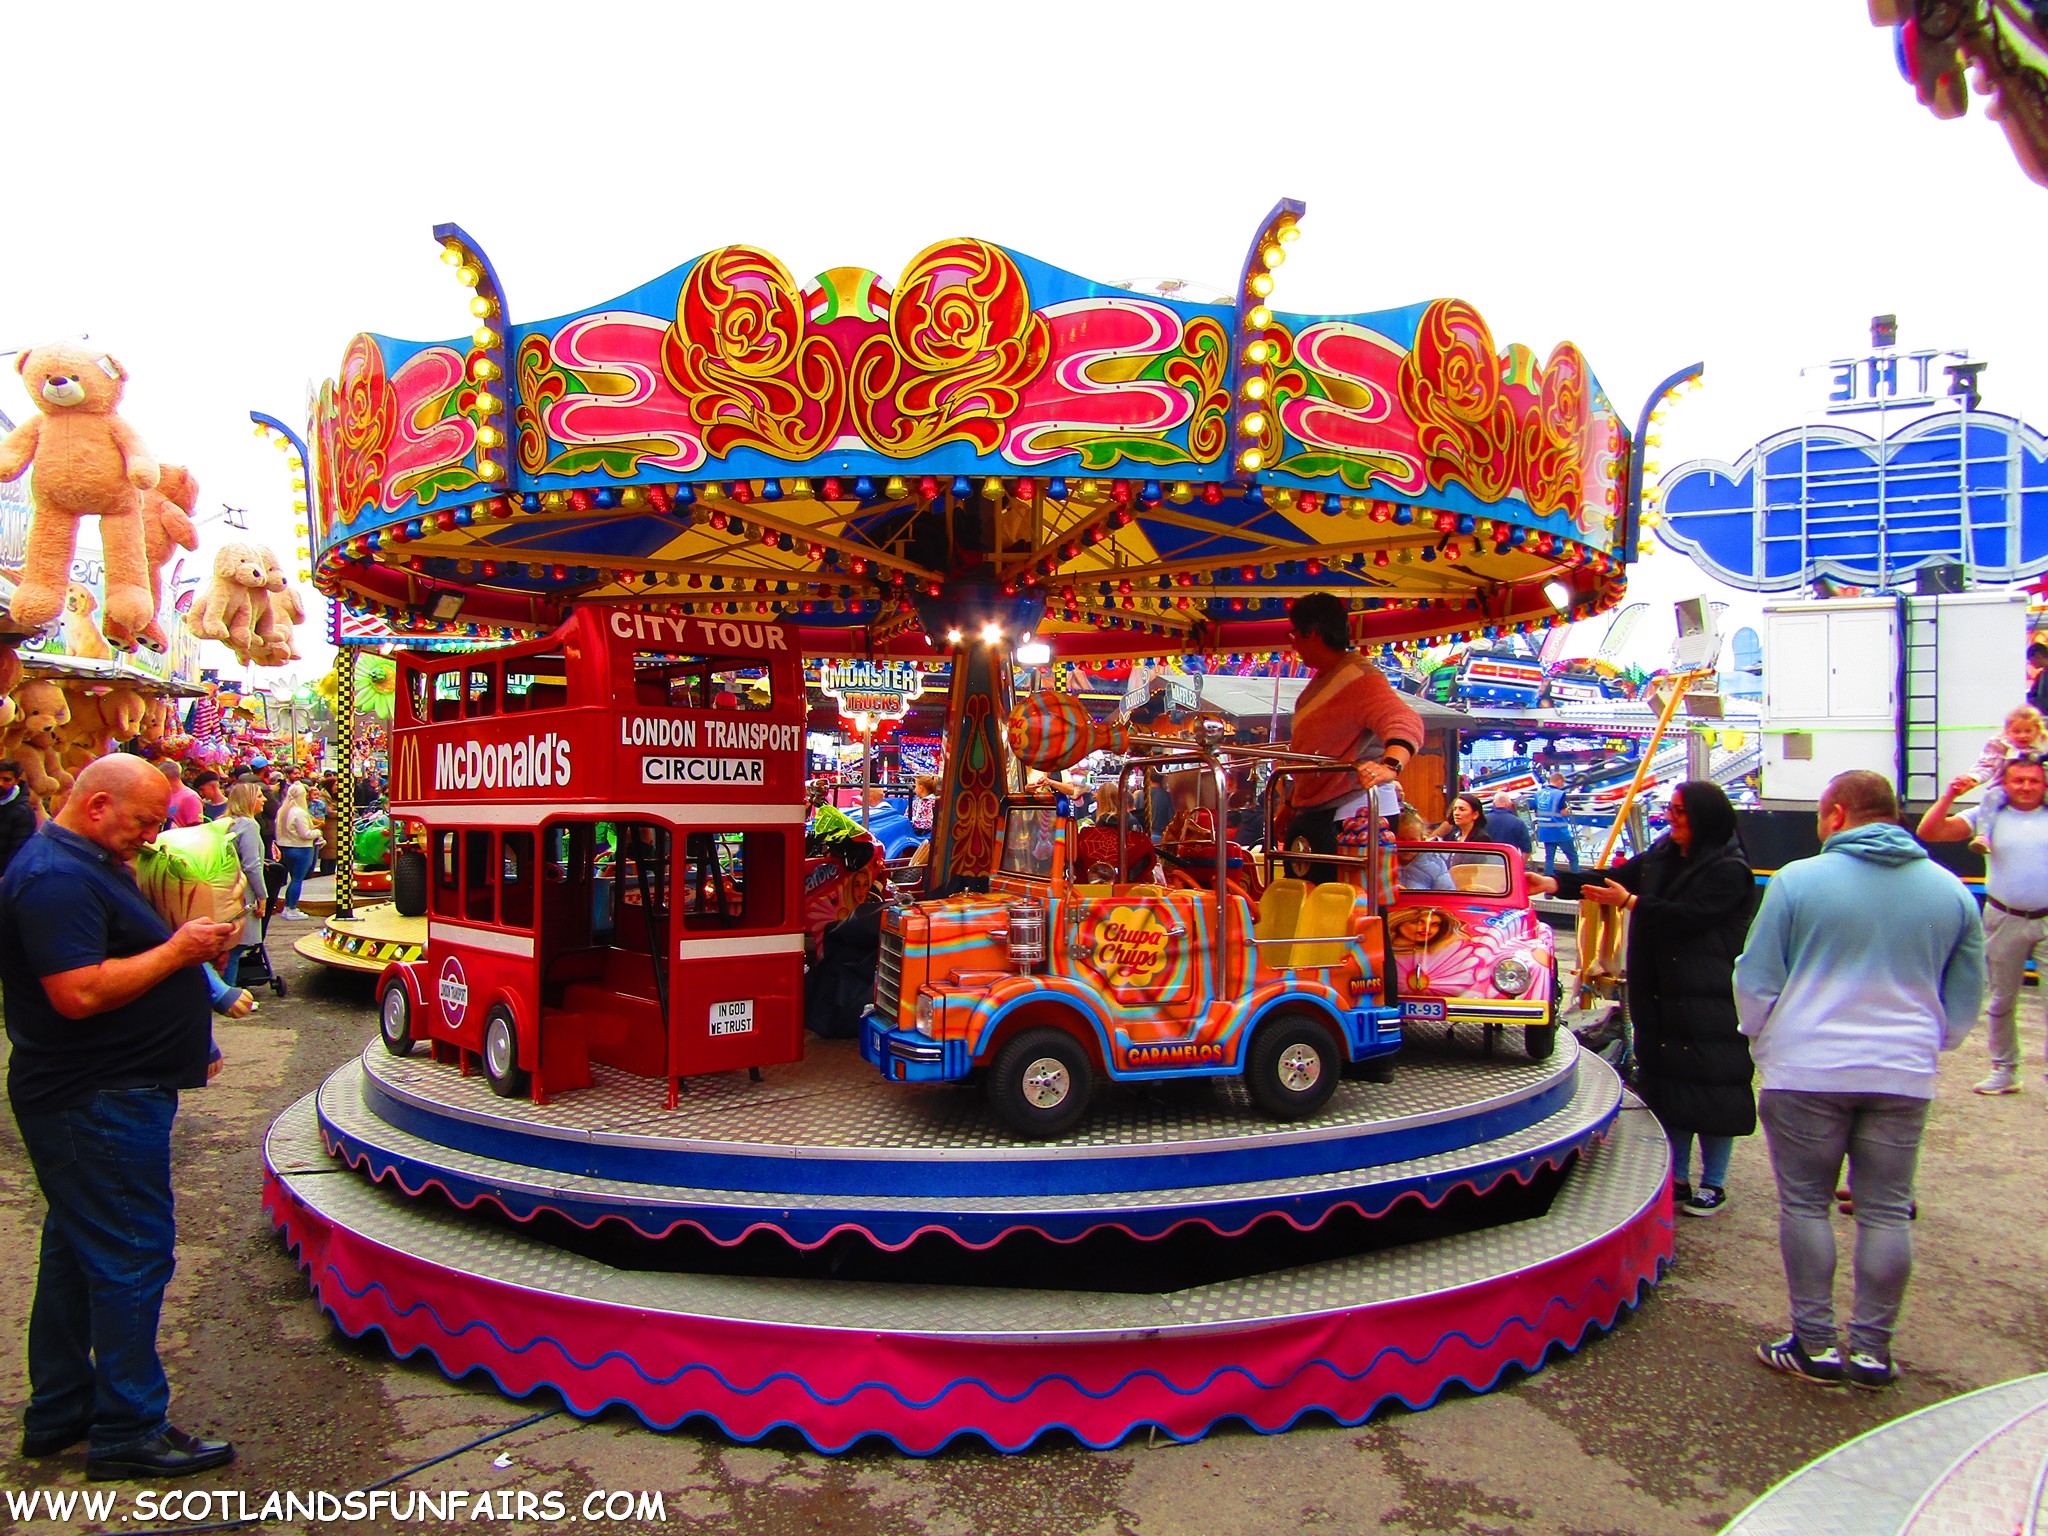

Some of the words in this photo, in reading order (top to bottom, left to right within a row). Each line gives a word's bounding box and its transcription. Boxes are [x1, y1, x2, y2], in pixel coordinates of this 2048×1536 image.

[610, 611, 687, 643] CITY
[697, 620, 788, 650] TOUR
[828, 662, 915, 692] MONSTER
[844, 692, 901, 711] TRUCKS
[1125, 687, 1147, 709] DONUTS
[1171, 682, 1197, 709] WAFFLES
[621, 716, 696, 747] LONDON
[704, 720, 800, 751] TRANSPORT
[435, 732, 571, 791] McDonald's
[645, 758, 762, 781] CIRCULAR
[805, 862, 839, 893] arbie
[1103, 922, 1163, 949] Chupa
[1098, 943, 1158, 969] Chups
[1350, 977, 1382, 995] DULCES
[718, 1004, 727, 1017] IN
[728, 1002, 746, 1016] GOD
[1408, 1004, 1442, 1016] R-93
[711, 1022, 722, 1035] WE
[725, 1018, 751, 1033] TRUST
[1127, 1044, 1222, 1066] CARAMELOS
